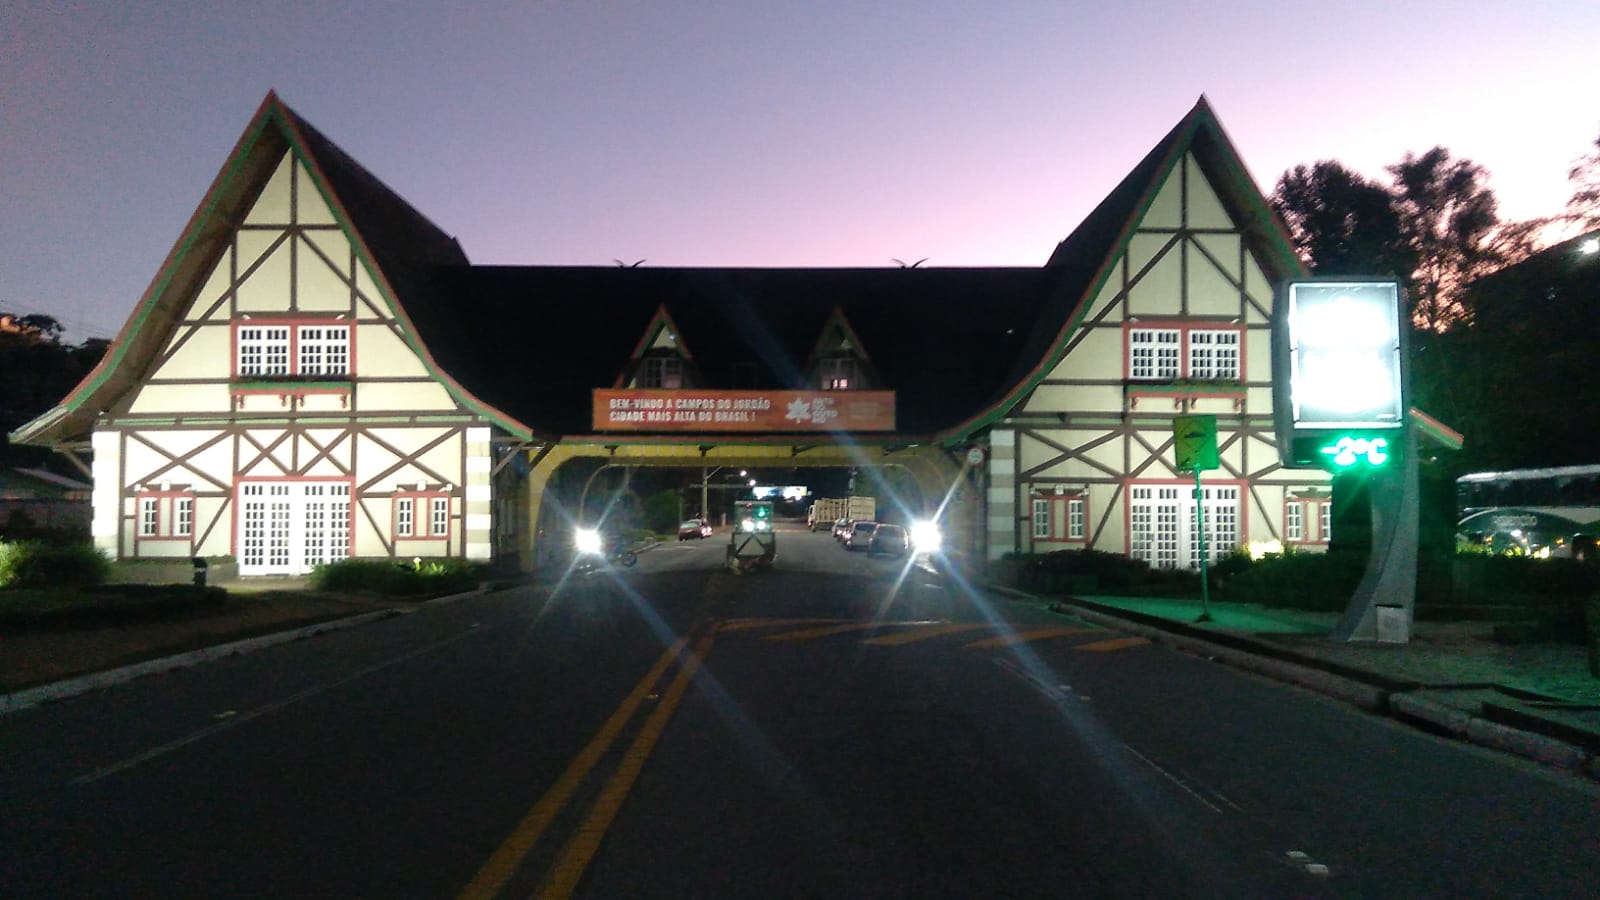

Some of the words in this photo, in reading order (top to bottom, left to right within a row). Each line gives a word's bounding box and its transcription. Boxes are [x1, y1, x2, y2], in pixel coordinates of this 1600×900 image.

[609, 398, 663, 409] BEM-VINDO
[666, 398, 673, 409] A
[675, 398, 715, 409] CAMPOS
[717, 398, 731, 409] DO
[733, 396, 771, 410] JORDÃO
[609, 411, 645, 421] CIDADE
[646, 411, 671, 421] MAIS
[673, 411, 696, 421] ALTA
[698, 411, 712, 421] DO
[715, 411, 749, 422] BRASIL
